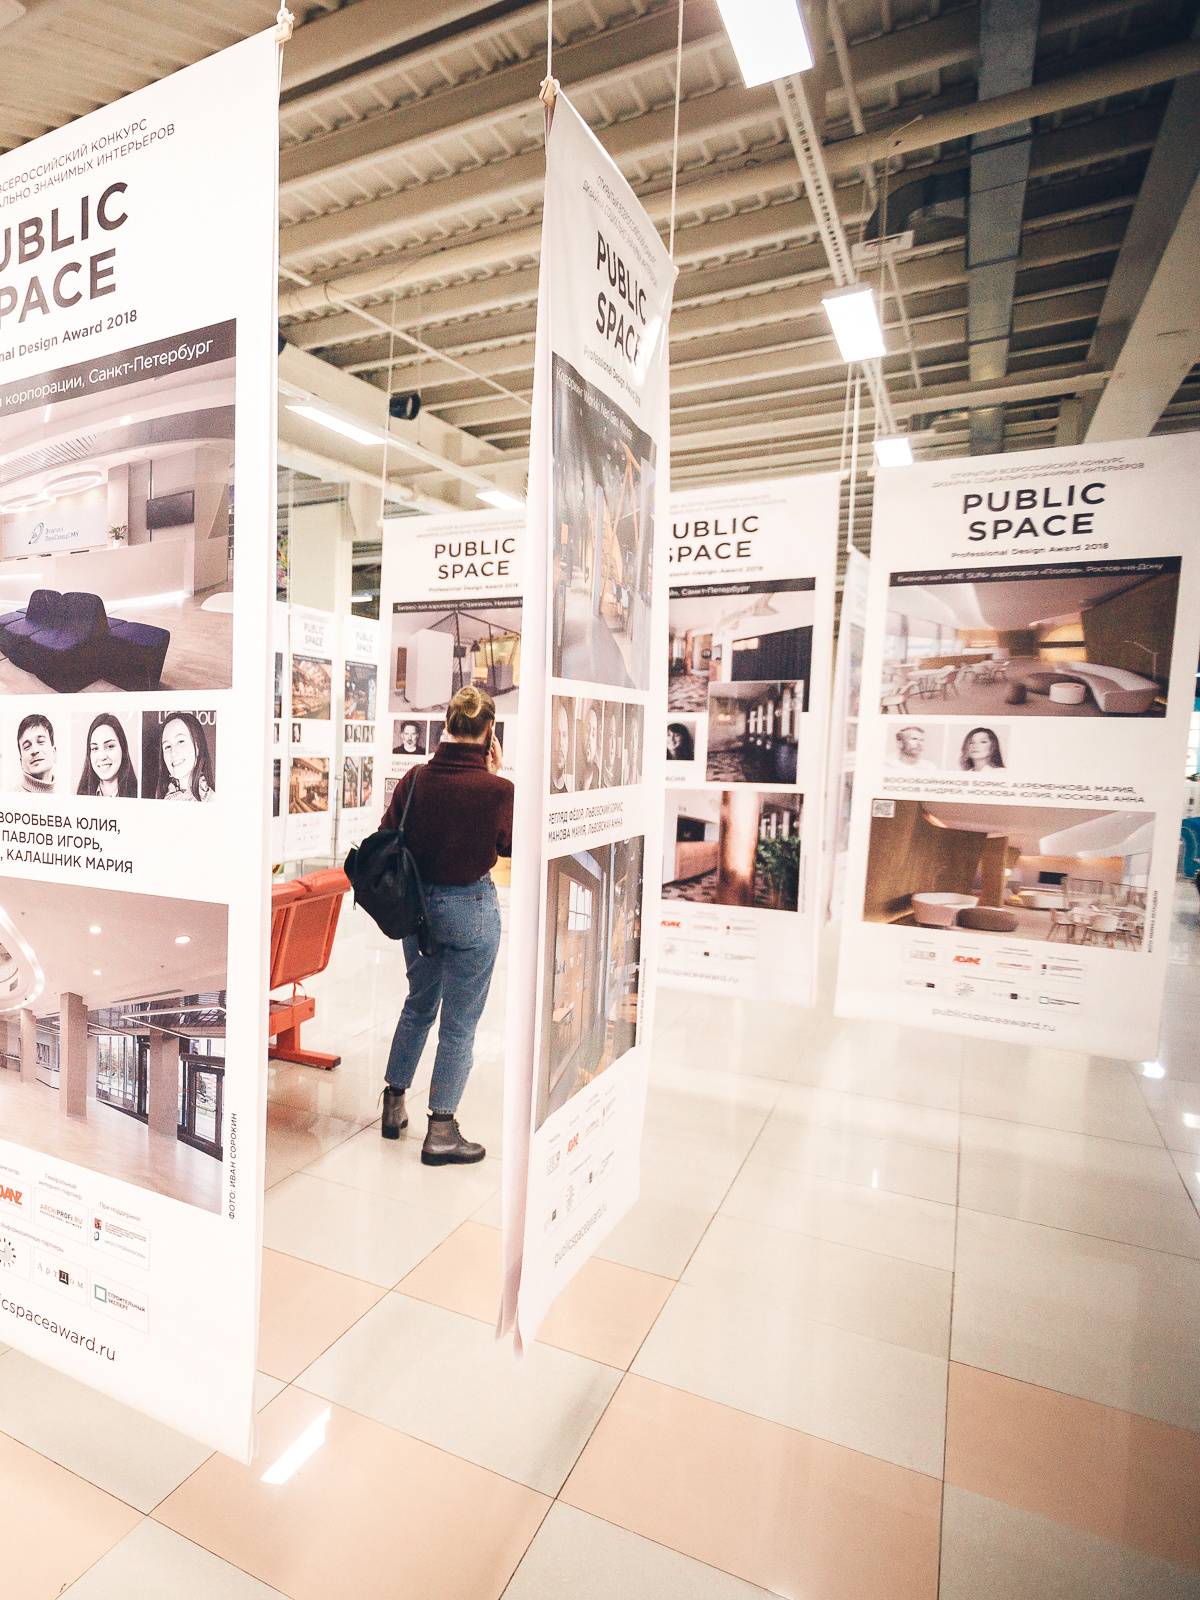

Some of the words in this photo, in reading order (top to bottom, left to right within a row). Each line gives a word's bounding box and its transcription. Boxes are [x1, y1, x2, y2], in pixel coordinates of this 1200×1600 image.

[91, 118, 148, 151] КОНКУРС
[33, 161, 94, 198] ЗНАЧИМЫХ
[96, 123, 175, 167] ИНТЕРЬЕРОВ
[596, 230, 647, 326] PUBLIC
[19, 334, 58, 358] Design
[62, 321, 102, 343] Award
[107, 310, 138, 330] 2018
[596, 291, 641, 366] SPACE
[5, 376, 85, 405] корпорации,
[88, 338, 214, 384] Санкт-Петербург
[963, 483, 1107, 514] PUBLIC
[673, 516, 758, 539] UBLIC
[968, 512, 1095, 541] SPACE
[434, 538, 515, 558] PUBLIC
[951, 548, 1008, 559] Professional
[1011, 546, 1045, 556] Design
[1050, 544, 1082, 552] Award
[1085, 542, 1109, 550] 2018
[438, 560, 510, 579] SPACE
[76, 817, 121, 834] ЮЛИЯ,
[2, 829, 54, 847] ПАВЛОВ
[57, 834, 103, 853] ИГОРЬ,
[6, 848, 82, 869] КАЛАШНИК
[85, 856, 134, 874] МАРИЯ
[657, 966, 739, 984] blicspaceaward.ru
[932, 1007, 1056, 1032] publicspaceaward.ru
[230, 1113, 238, 1159] СОРОКИН
[229, 1190, 237, 1219] ФОТО:
